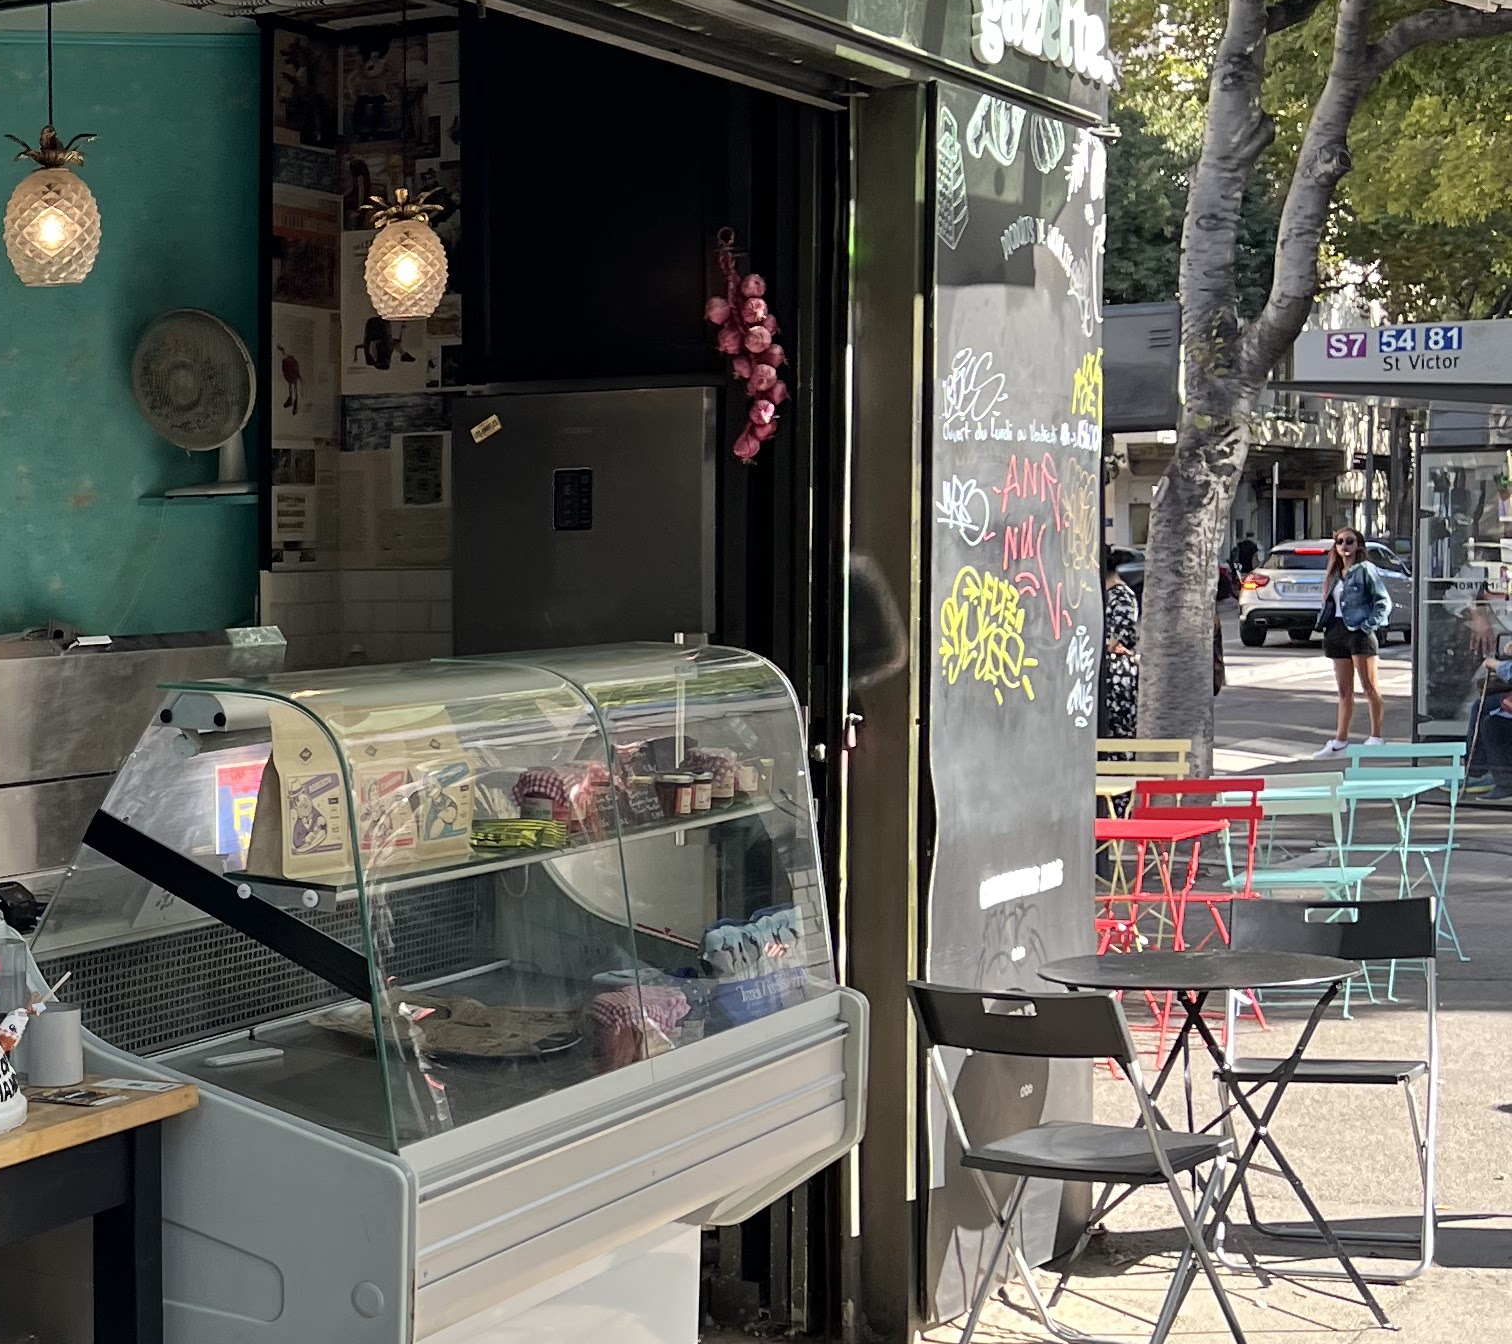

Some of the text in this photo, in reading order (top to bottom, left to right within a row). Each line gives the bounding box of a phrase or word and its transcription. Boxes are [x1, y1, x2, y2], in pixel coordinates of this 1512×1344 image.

[1328, 327, 1459, 357] S7 54 81
[1383, 353, 1460, 372] St Victor
